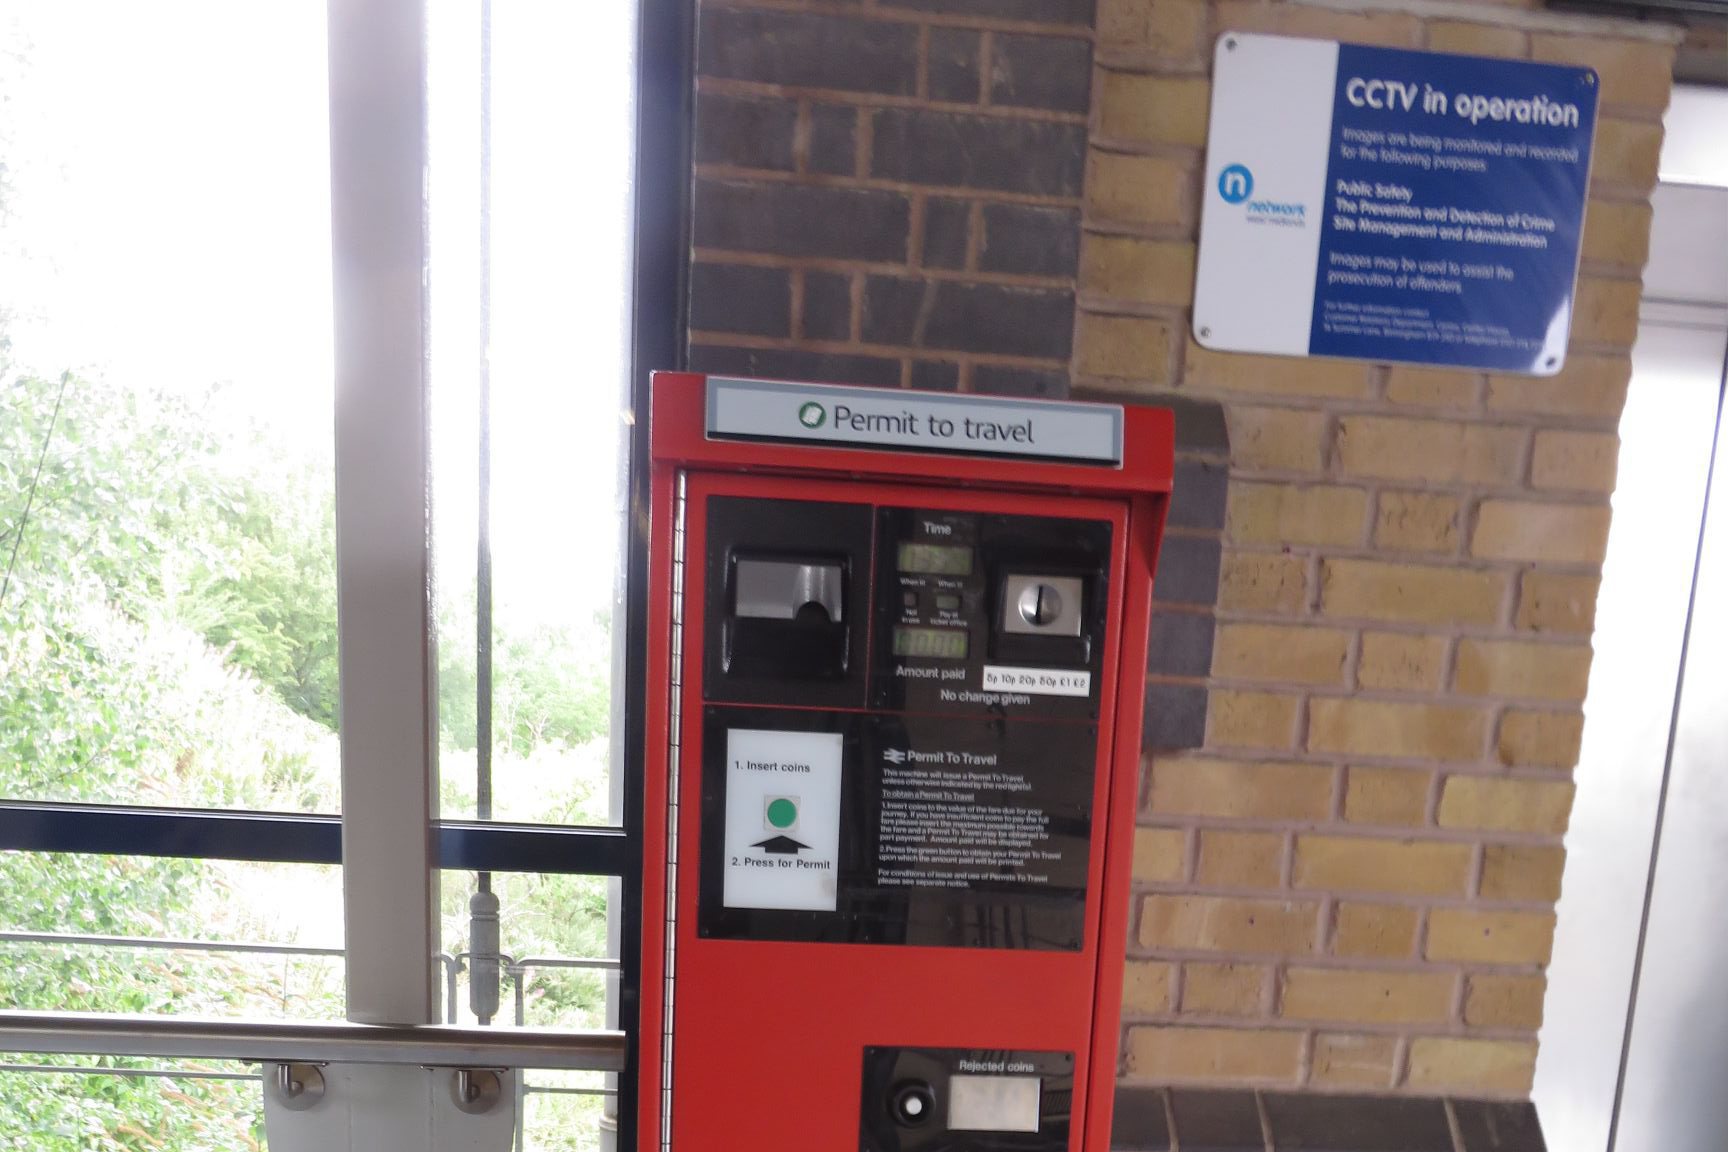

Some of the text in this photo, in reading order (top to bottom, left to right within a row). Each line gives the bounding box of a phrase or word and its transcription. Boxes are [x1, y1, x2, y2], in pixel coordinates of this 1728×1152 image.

[1346, 77, 1579, 128] CCTV in operation
[1336, 179, 1413, 201] Public Safety
[1335, 197, 1555, 231] The Prevention and Detection of Crime
[1333, 215, 1548, 250] Site Management and Administration
[834, 405, 1034, 443] Permit to travel
[924, 522, 952, 535] Time
[896, 665, 966, 680] Amount paid
[1002, 674, 1016, 685] 10p
[1019, 675, 1036, 687] 20p
[941, 689, 1031, 706] No change given
[907, 750, 997, 766] Permit To Travel
[735, 761, 811, 773] 1. Insert coins
[732, 857, 831, 869] 2. Press for Permit
[960, 1060, 1035, 1073] Rejected coins
